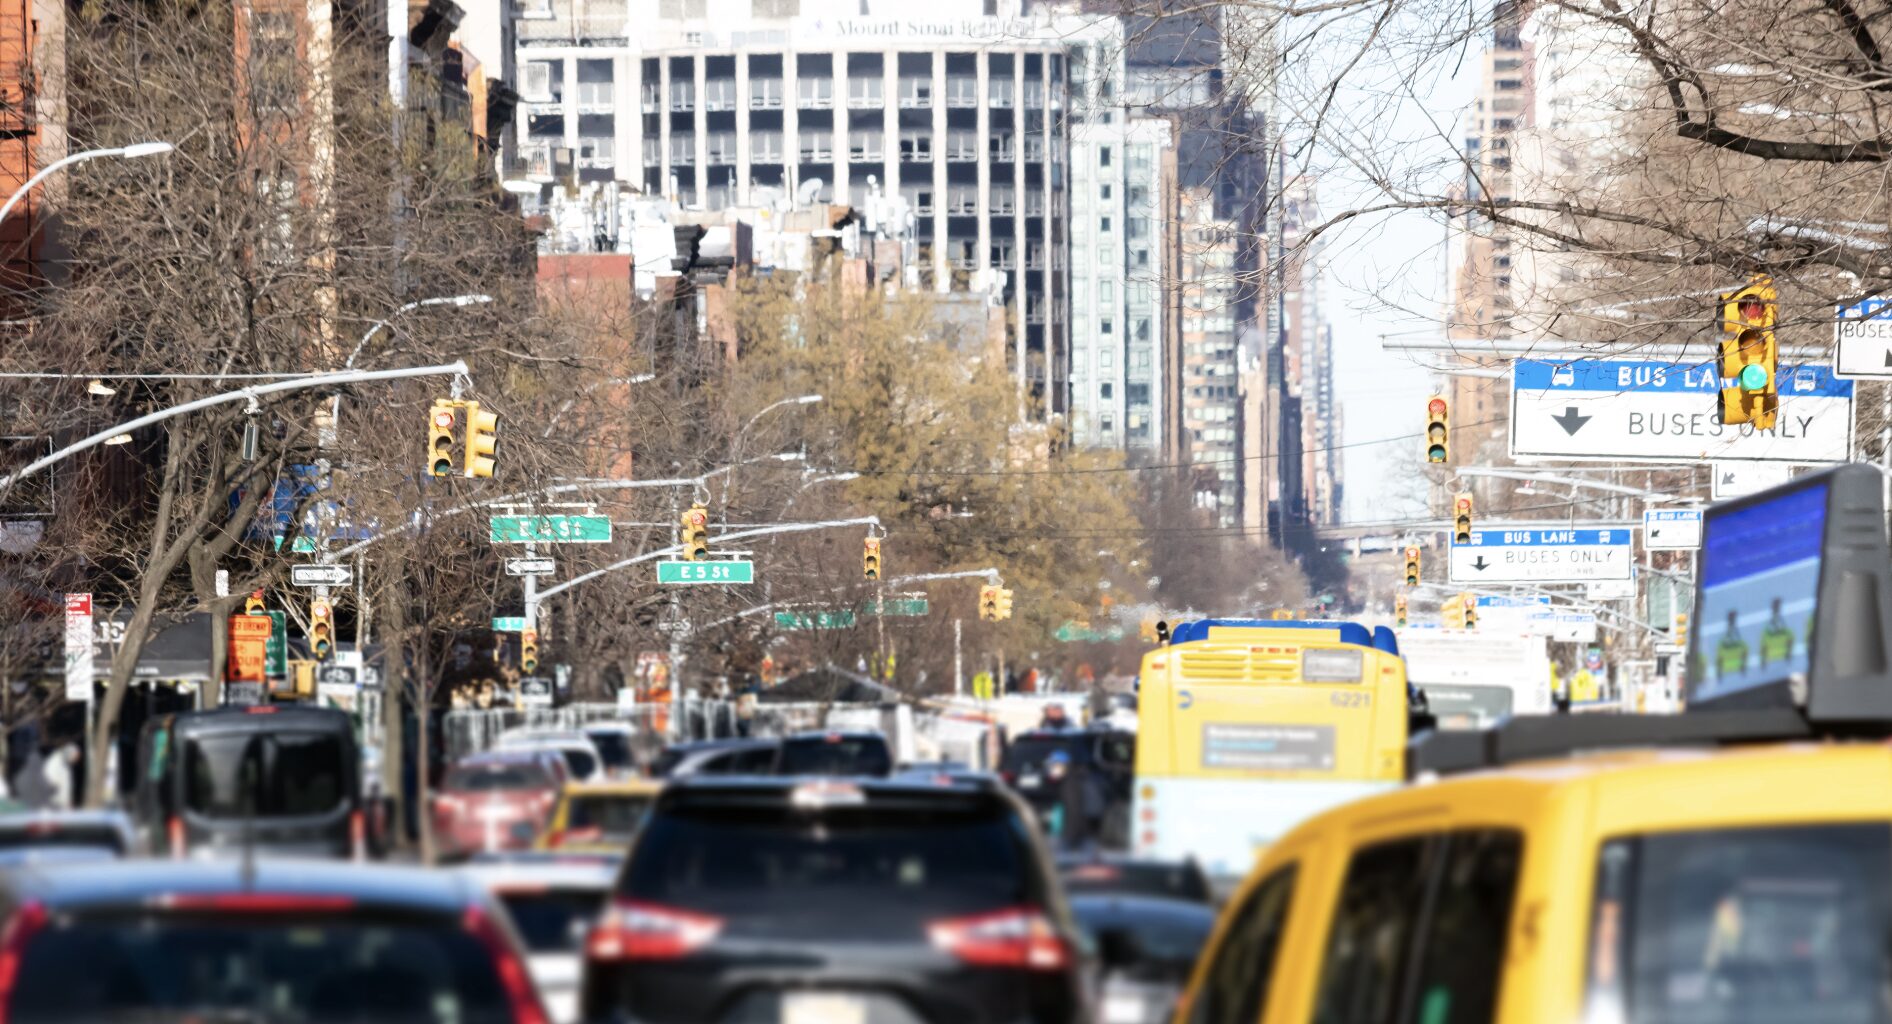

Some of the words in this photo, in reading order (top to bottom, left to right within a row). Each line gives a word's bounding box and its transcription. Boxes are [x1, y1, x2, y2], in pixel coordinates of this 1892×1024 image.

[836, 20, 899, 36] Mount
[906, 19, 954, 36] Sinai
[1844, 323, 1892, 338] BUSE
[1618, 366, 1667, 387] BUS
[1683, 369, 1740, 389] LAN
[1628, 412, 1724, 436] BUSES
[519, 521, 530, 537] E
[559, 520, 582, 536] St
[1503, 532, 1531, 544] BUS
[1541, 531, 1577, 544] LANE
[1505, 550, 1560, 564] BUSES
[1570, 549, 1614, 563] ONLY
[680, 566, 691, 579] E
[696, 566, 706, 579] 5
[711, 565, 731, 579] St
[1331, 691, 1371, 708] 6221
